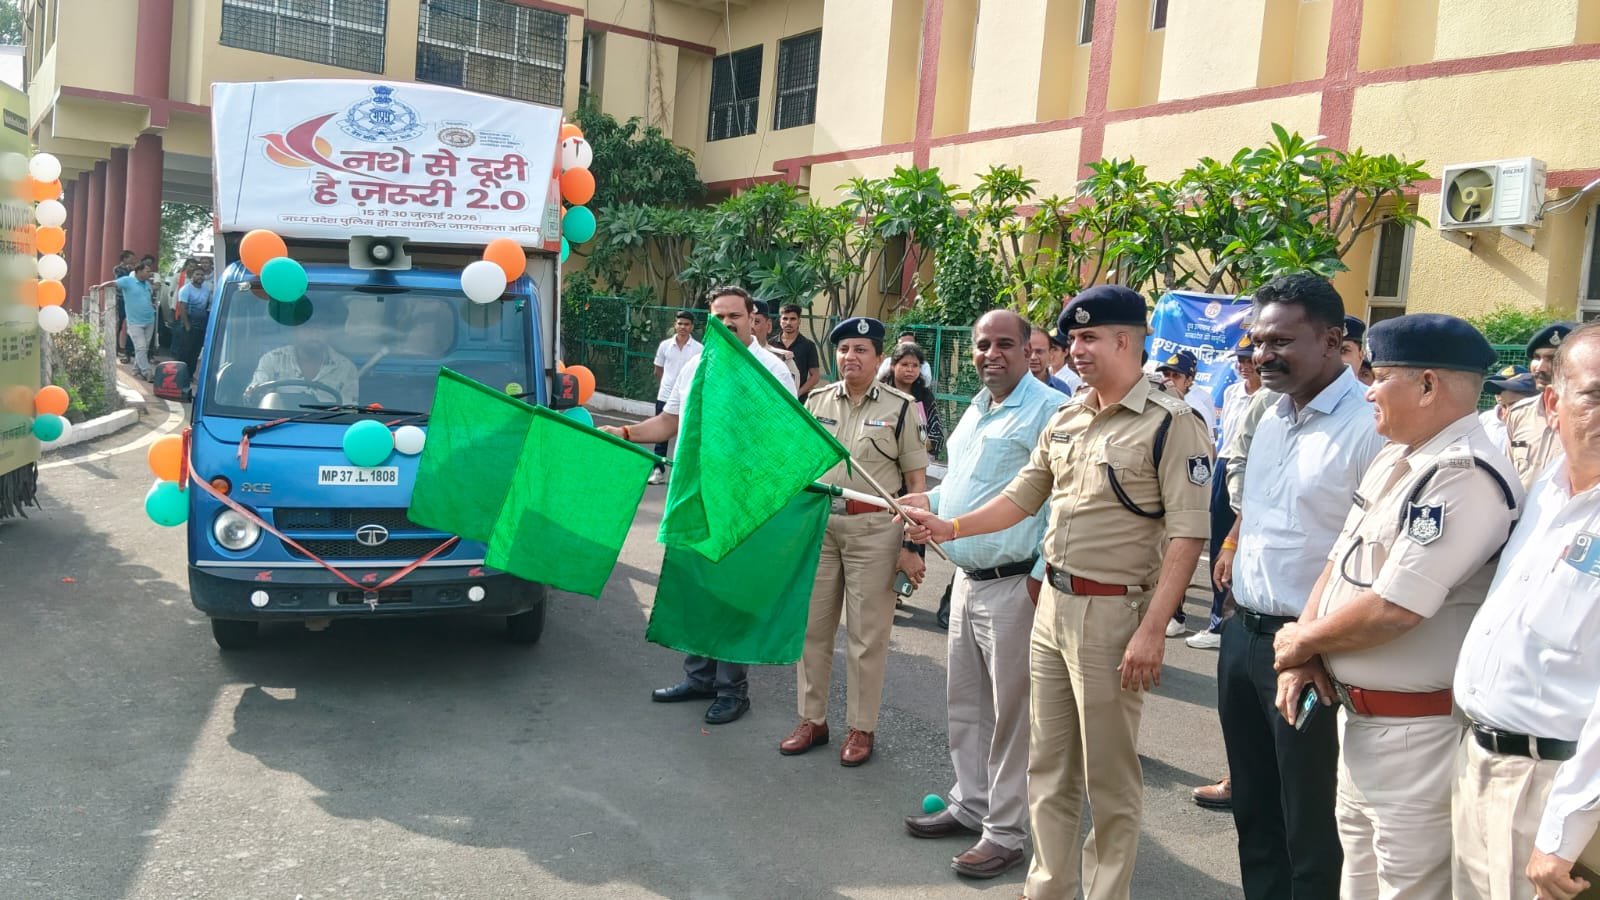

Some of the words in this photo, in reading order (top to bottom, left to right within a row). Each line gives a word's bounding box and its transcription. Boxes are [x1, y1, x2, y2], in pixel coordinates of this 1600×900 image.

[340, 146, 415, 174] नशे
[422, 148, 461, 177] से
[467, 153, 528, 188] दूरी
[311, 171, 342, 205] है
[348, 179, 457, 208] ज़रूरी
[466, 188, 526, 210] 2.0
[282, 215, 308, 223] मध्य
[311, 216, 337, 224] प्रदेश
[340, 217, 374, 227] पुलिस
[376, 219, 398, 228] द्वारा
[401, 219, 447, 229] संचालित
[377, 209, 389, 217] से
[410, 211, 445, 221] जुलाई
[447, 213, 478, 222] 2026
[321, 469, 339, 482] MP
[340, 469, 353, 482] 37
[370, 469, 396, 483] 1808
[240, 482, 272, 494] ACE
